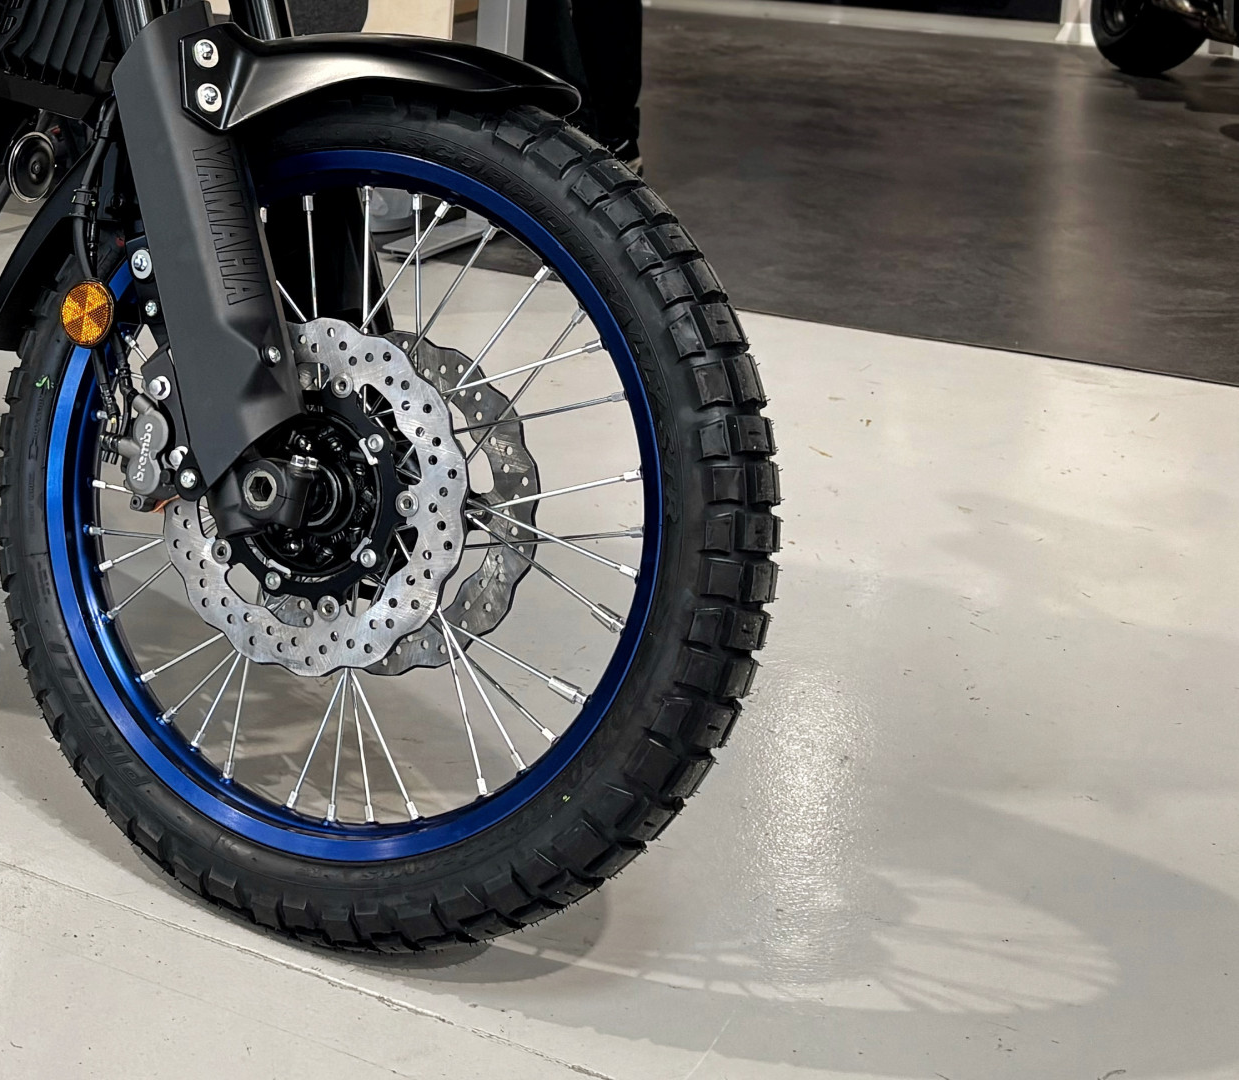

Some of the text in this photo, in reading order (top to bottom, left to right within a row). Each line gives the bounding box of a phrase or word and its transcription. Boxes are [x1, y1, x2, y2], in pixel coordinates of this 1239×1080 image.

[192, 138, 265, 306] YAMAHA
[132, 422, 154, 482] brembo
[48, 638, 151, 788] PIRELLI
